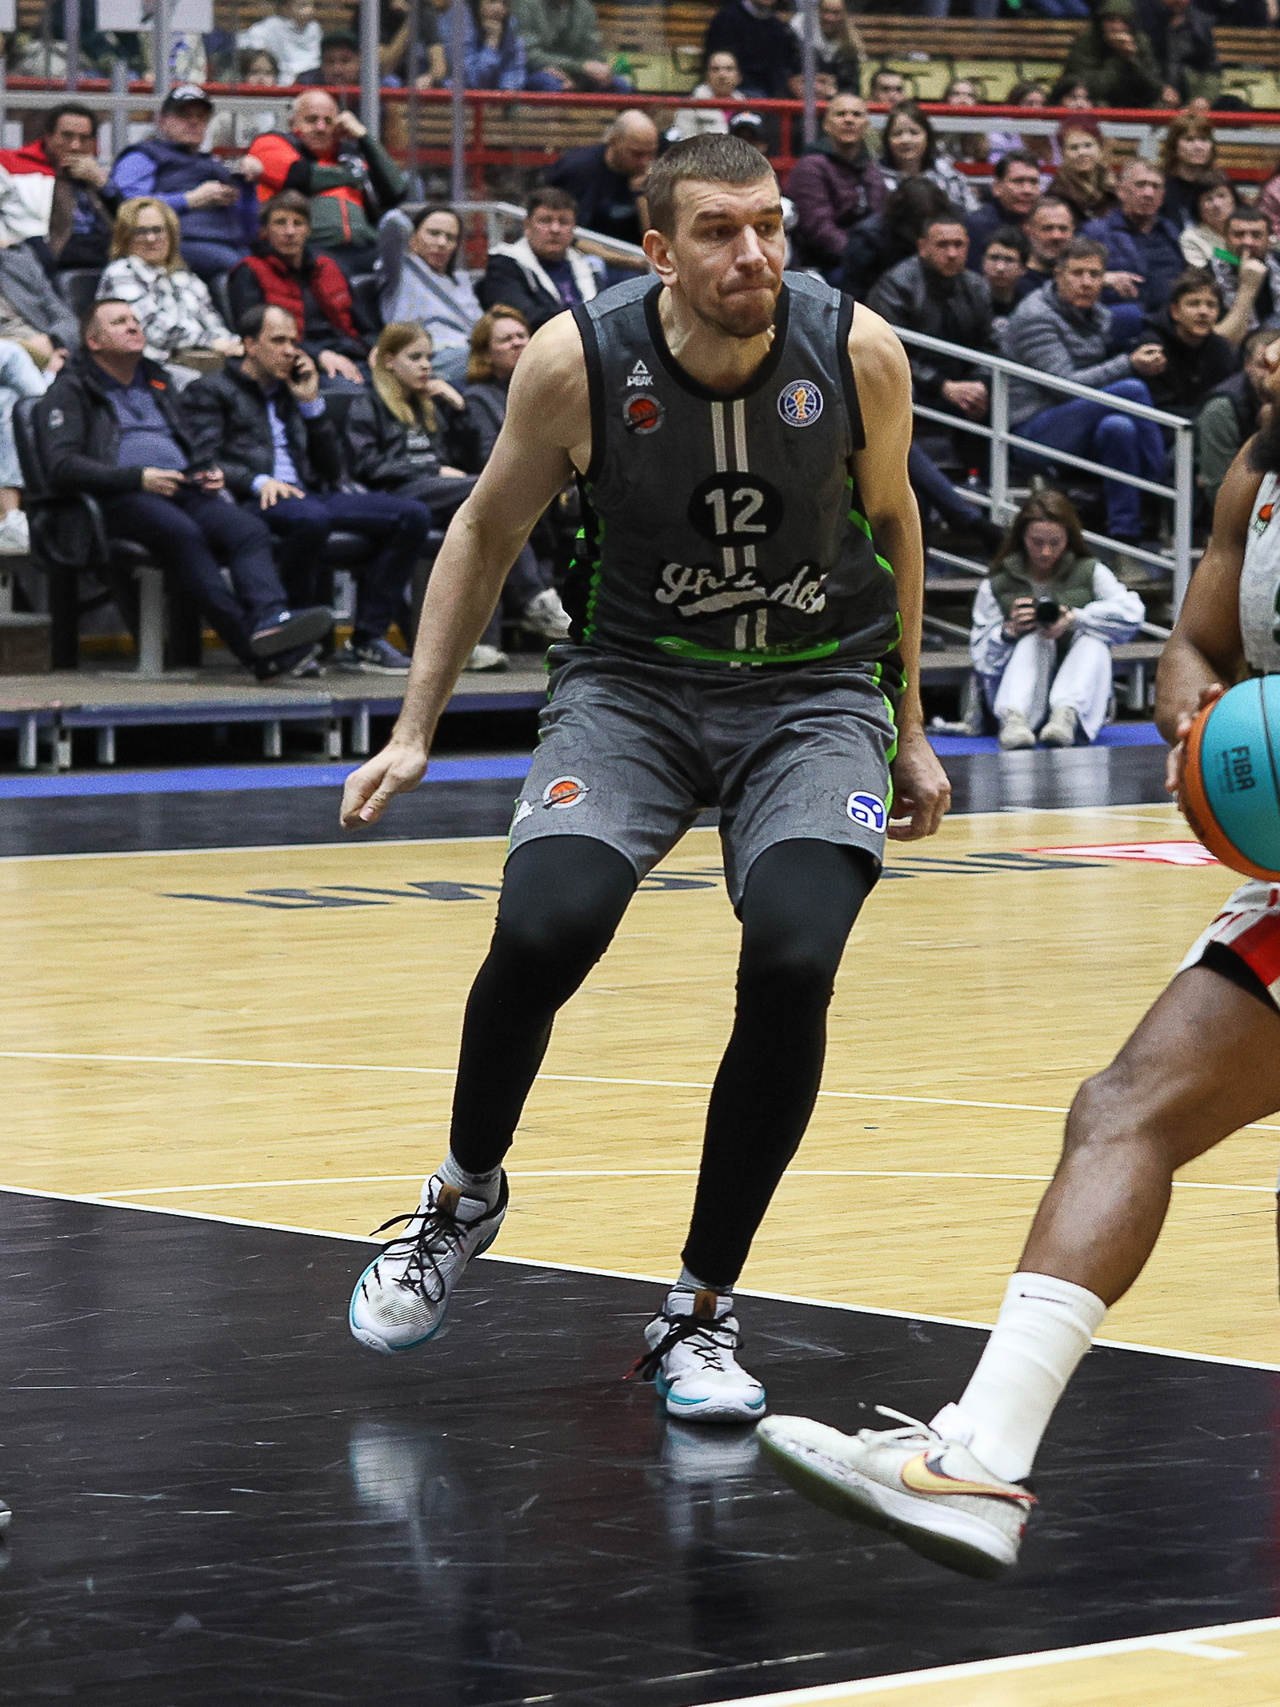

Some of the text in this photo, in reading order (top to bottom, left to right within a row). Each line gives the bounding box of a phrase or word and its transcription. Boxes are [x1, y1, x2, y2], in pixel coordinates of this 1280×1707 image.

[626, 375, 654, 387] PEAK
[704, 487, 767, 535] 12
[1231, 745, 1256, 791] FIBA
